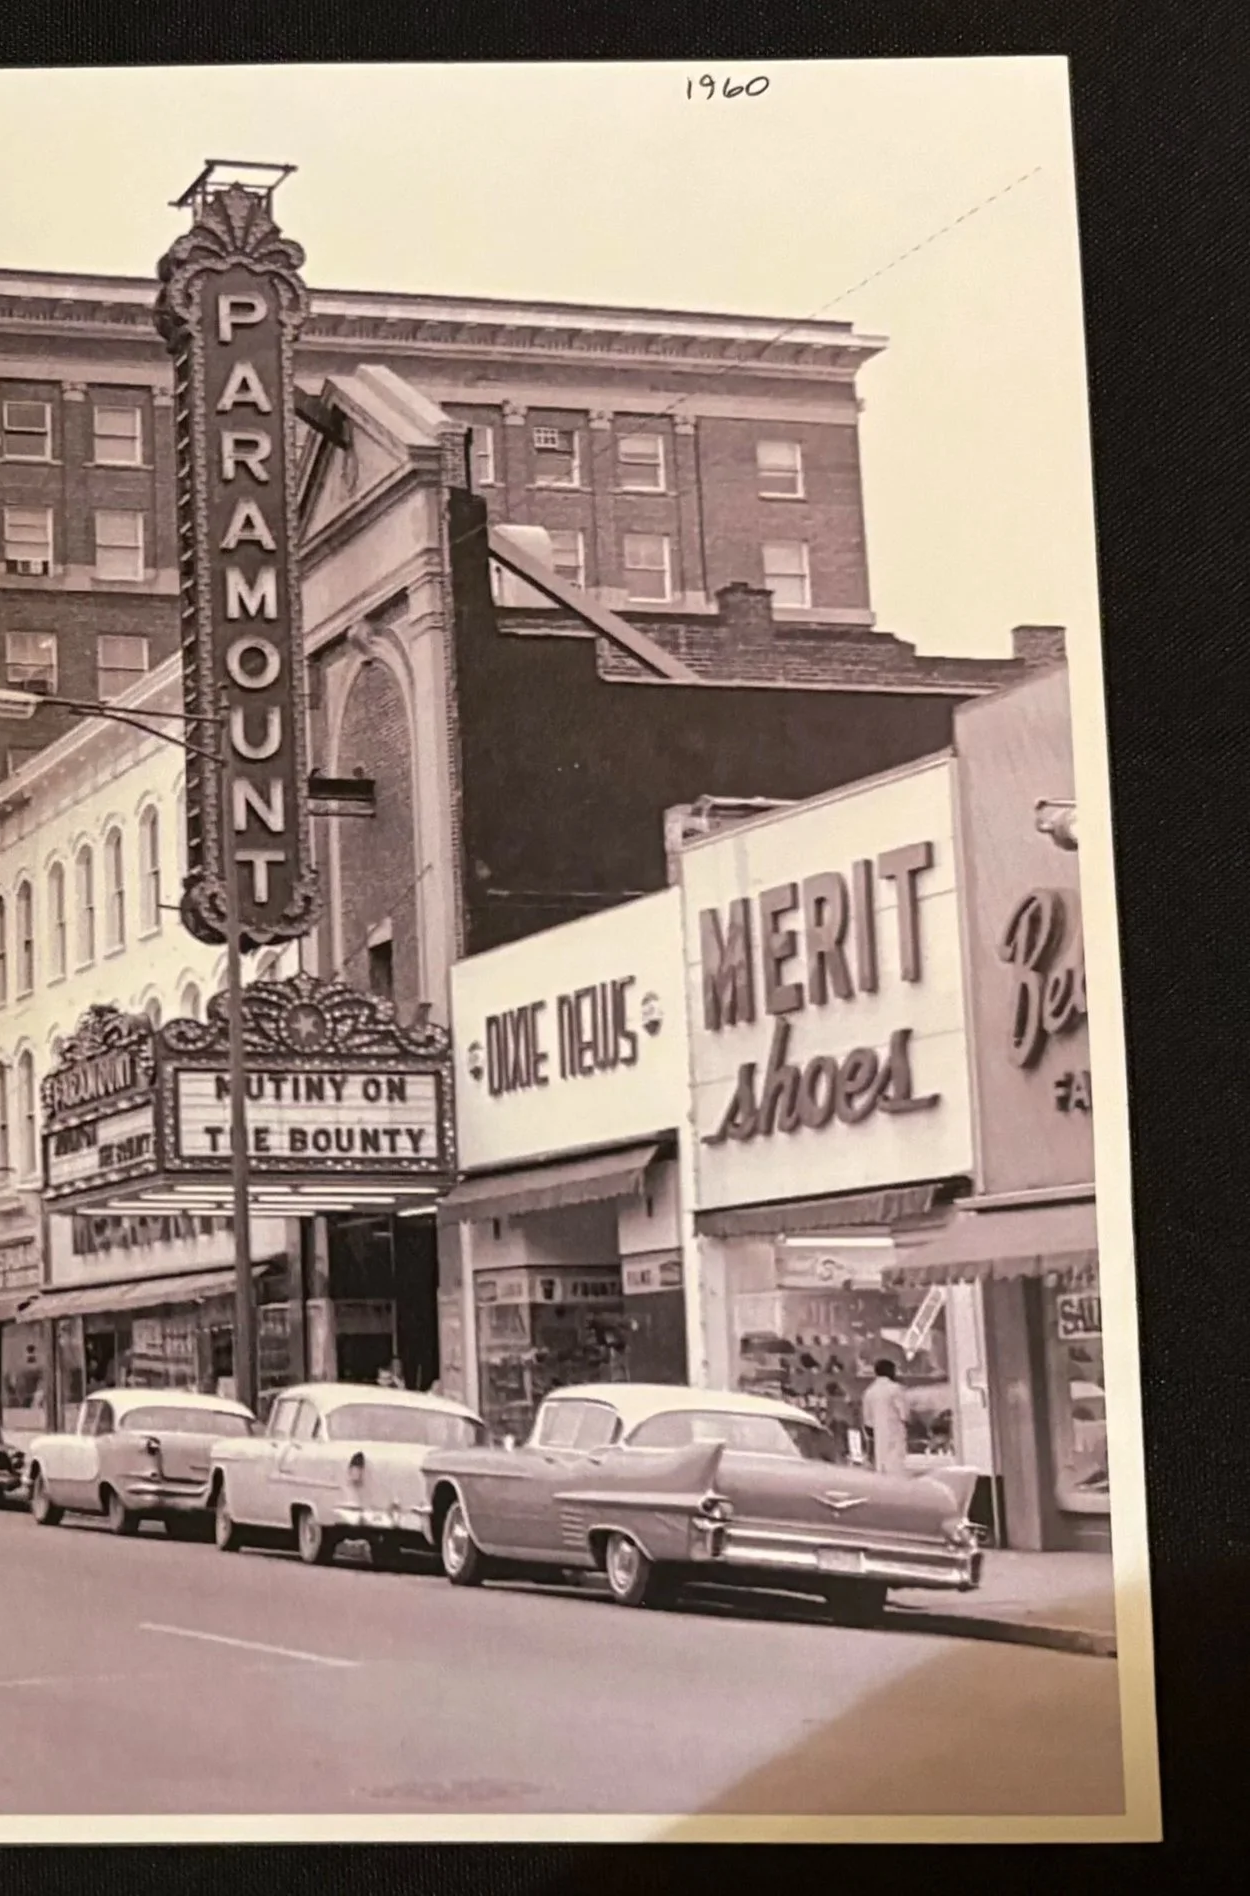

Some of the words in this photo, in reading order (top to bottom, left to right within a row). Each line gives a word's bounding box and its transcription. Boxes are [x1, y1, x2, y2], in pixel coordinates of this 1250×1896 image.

[686, 74, 769, 100] 1960
[215, 294, 286, 904] PARAMOUNT
[699, 841, 934, 1031] MERIT
[997, 887, 1087, 1070] Be
[362, 1077, 407, 1101] ON
[486, 1000, 549, 1098] DIXIE
[556, 974, 639, 1081] NEWS
[701, 1016, 942, 1145] shoes
[204, 1126, 271, 1152] TE
[289, 1127, 425, 1153] BOUNTY
